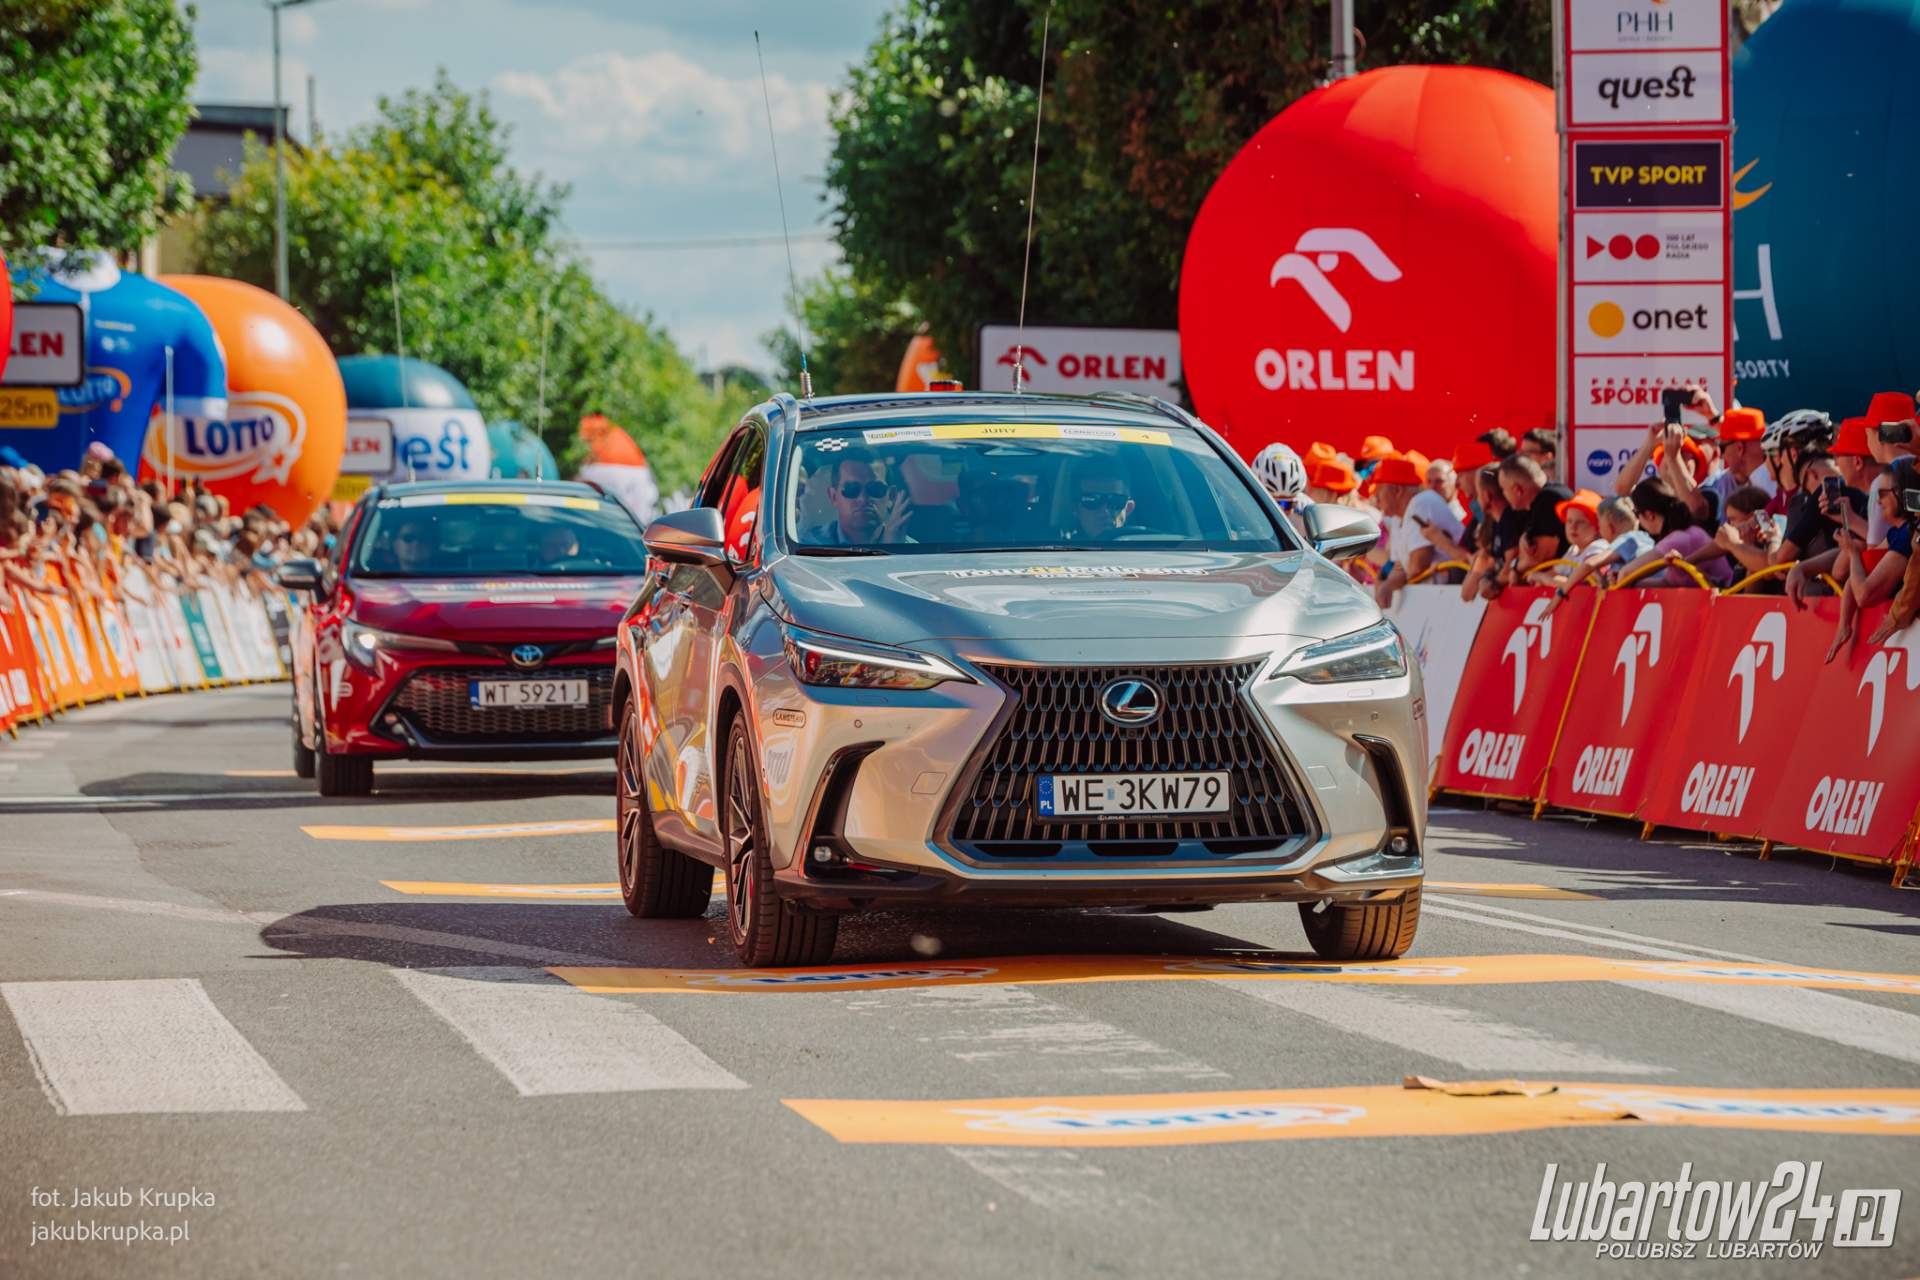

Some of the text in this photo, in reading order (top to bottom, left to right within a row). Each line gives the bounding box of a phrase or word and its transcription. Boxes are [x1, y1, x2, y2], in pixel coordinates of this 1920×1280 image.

[1617, 11, 1673, 32] PHH
[1598, 66, 1695, 109] quest
[1590, 165, 1706, 184] TVP SPORT
[1632, 305, 1708, 330] onet
[1058, 354, 1165, 379] ORLEN
[1255, 348, 1415, 391] ORLEN
[1734, 359, 1790, 378] SORTY
[185, 415, 274, 456] LOTTO
[401, 417, 469, 470] est
[484, 683, 581, 703] WT 5921J
[1457, 728, 1526, 780] ORLEN
[1571, 744, 1634, 796] ORLEN
[1040, 801, 1053, 810] PL
[1062, 776, 1221, 811] WE 3KW79
[1680, 761, 1755, 818] ORLEN
[1805, 775, 1884, 837] ORLEN
